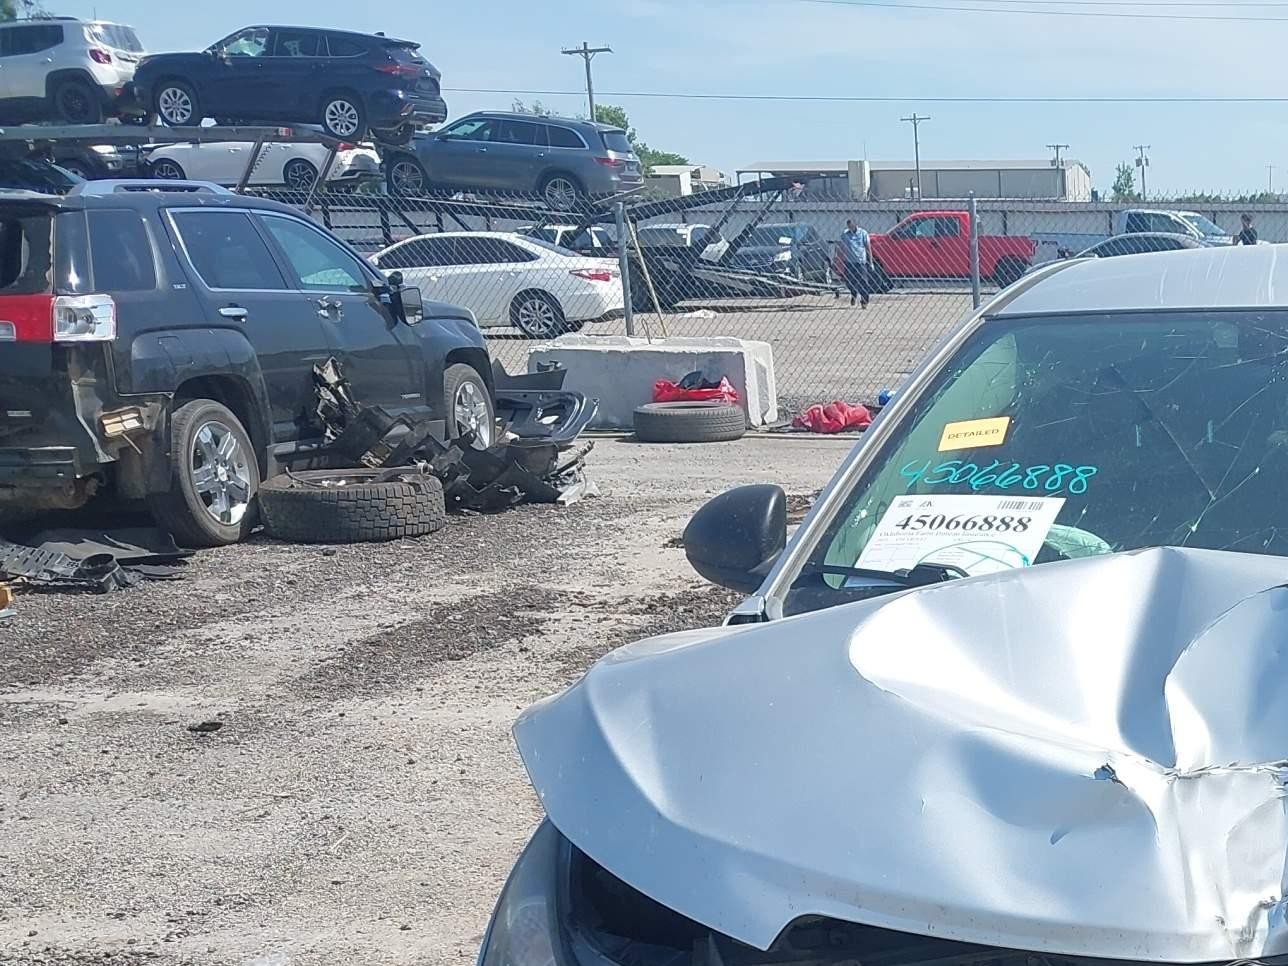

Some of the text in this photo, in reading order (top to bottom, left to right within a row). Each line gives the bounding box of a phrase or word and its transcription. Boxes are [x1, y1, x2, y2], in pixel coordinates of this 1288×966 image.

[947, 428, 1000, 440] DETAILED
[900, 459, 1098, 494] 45066888
[895, 514, 1032, 533] 45066888
